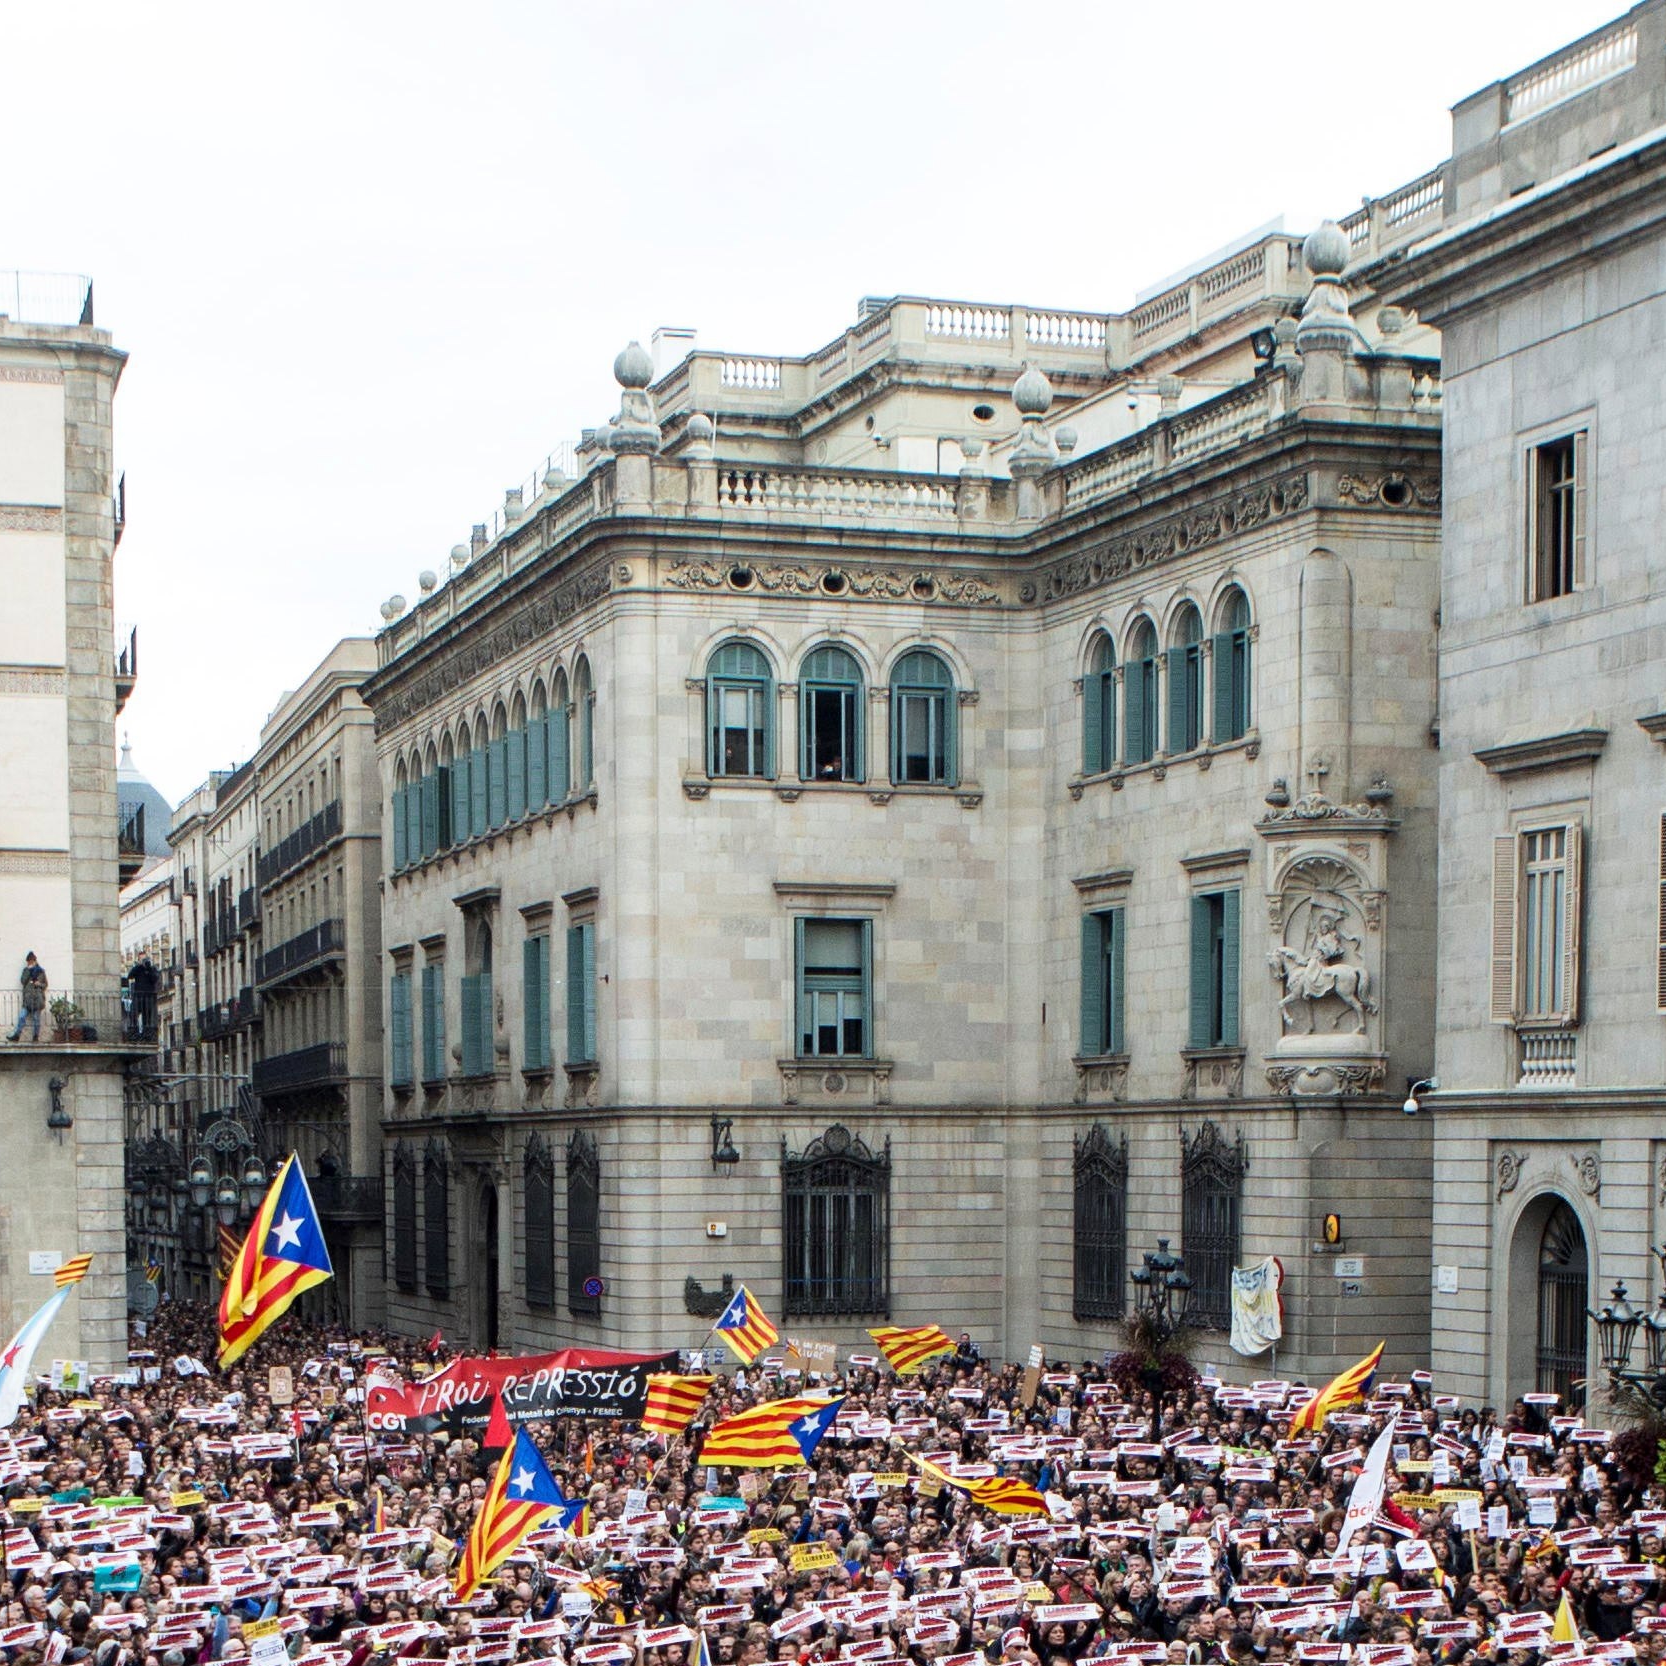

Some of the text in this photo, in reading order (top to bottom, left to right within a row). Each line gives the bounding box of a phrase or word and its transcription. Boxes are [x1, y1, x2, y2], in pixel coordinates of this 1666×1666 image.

[501, 1366, 640, 1405] REPRESSIÓ
[368, 1412, 408, 1430] CGT
[593, 1408, 623, 1417] FEMEC
